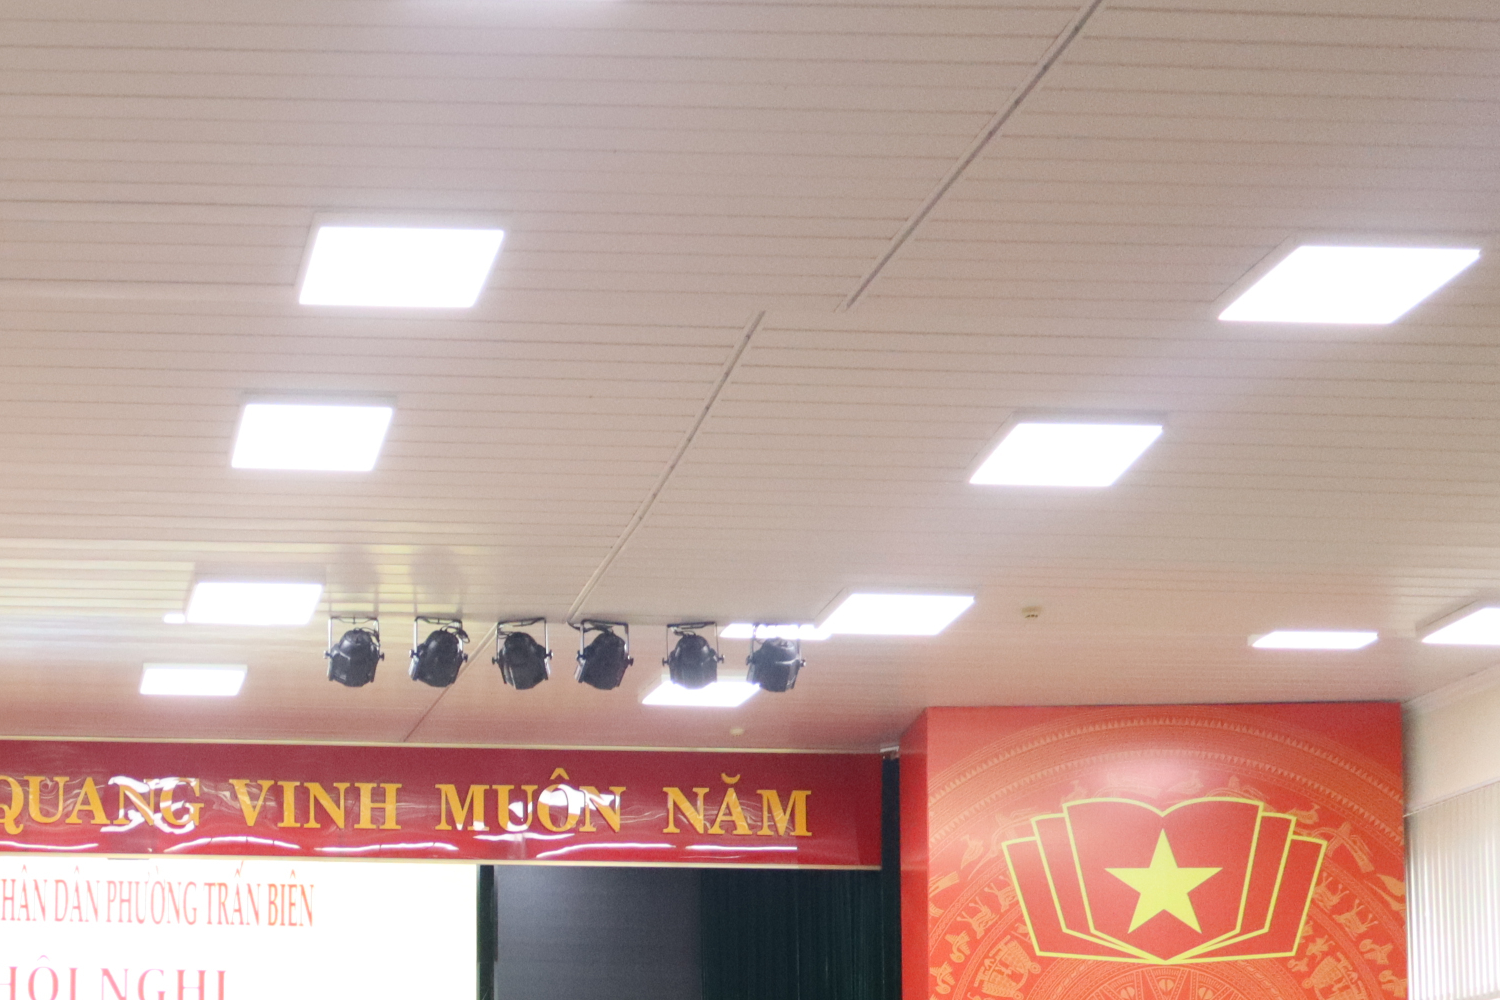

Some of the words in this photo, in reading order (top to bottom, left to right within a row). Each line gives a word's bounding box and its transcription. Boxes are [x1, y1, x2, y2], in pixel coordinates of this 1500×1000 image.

[229, 779, 402, 830] VINH
[435, 767, 627, 834] MUÔN
[663, 772, 812, 837] NĂM
[54, 865, 101, 923] DÂN
[106, 865, 198, 926] PHƯỜNG
[204, 860, 261, 926] TRẤN
[267, 869, 314, 927] BIÊN
